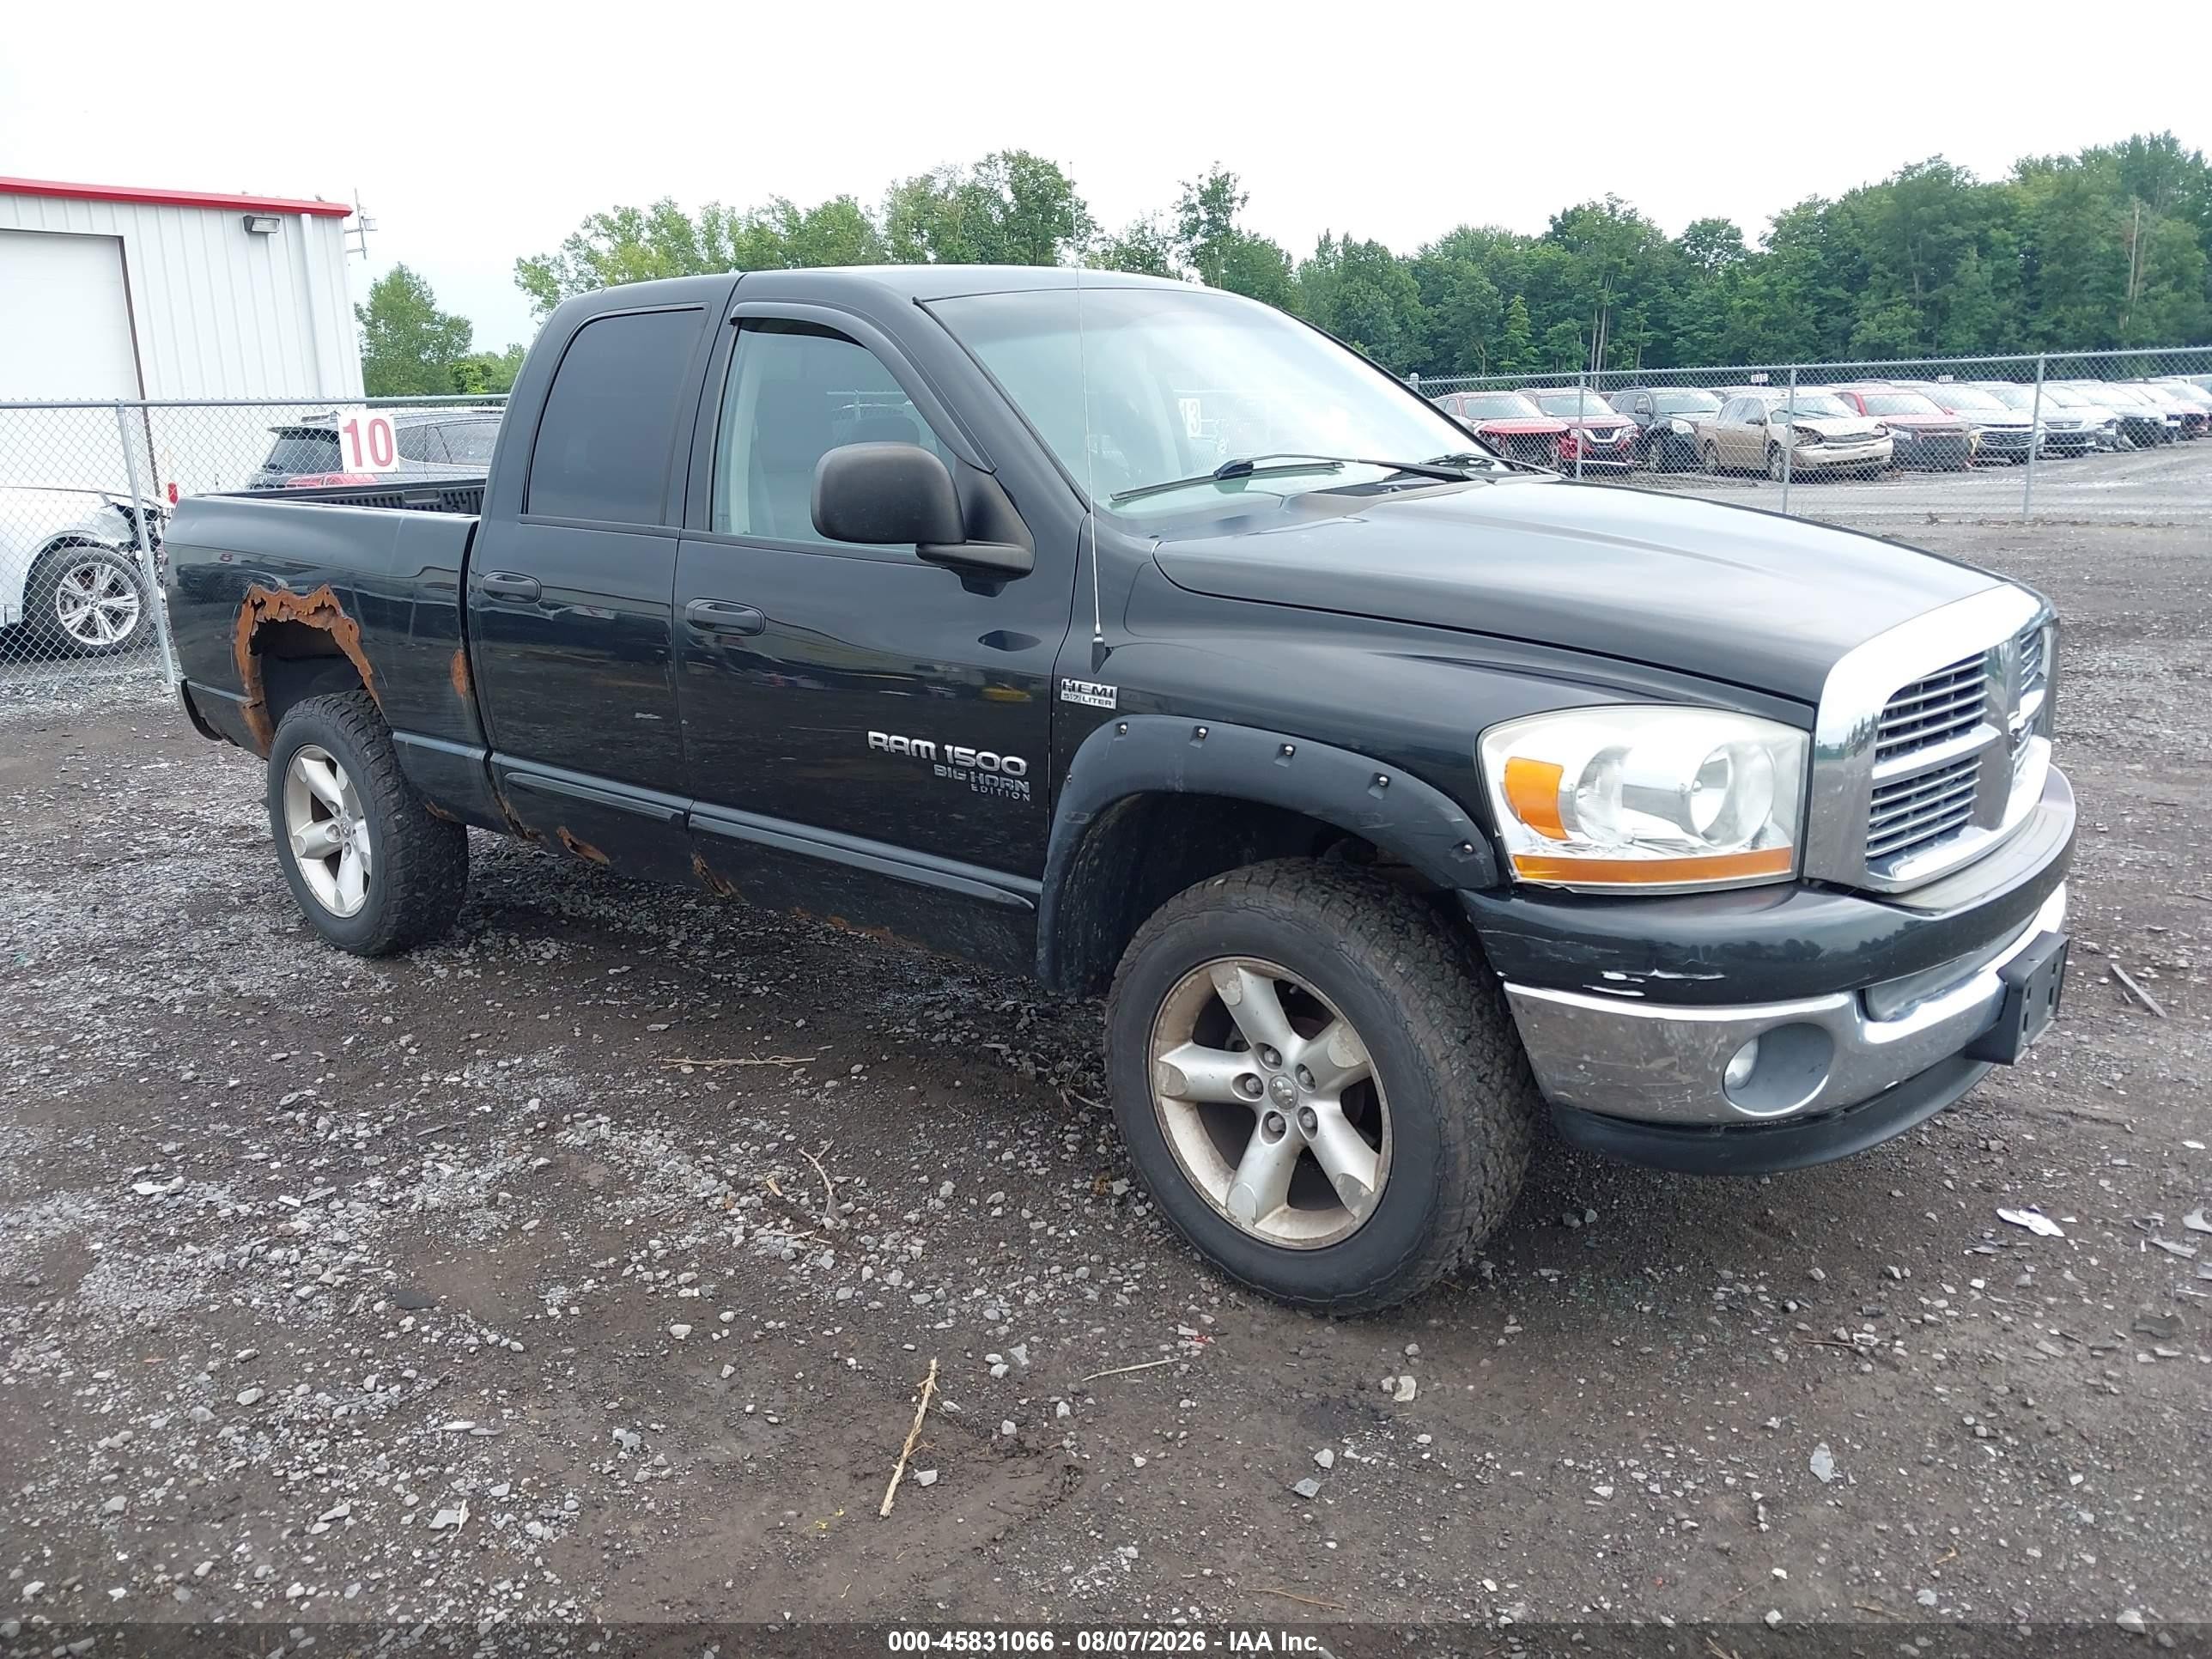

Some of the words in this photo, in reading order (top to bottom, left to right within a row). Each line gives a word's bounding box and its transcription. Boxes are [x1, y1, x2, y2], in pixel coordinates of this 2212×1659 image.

[343, 418, 393, 468] 10
[1062, 680, 1114, 698] HEMI
[1082, 695, 1112, 707] LITER
[867, 730, 938, 761] RAM
[944, 744, 1028, 776] 1500
[933, 764, 967, 781] BIG
[969, 771, 1030, 793] HORN
[970, 783, 1030, 802] EDITION
